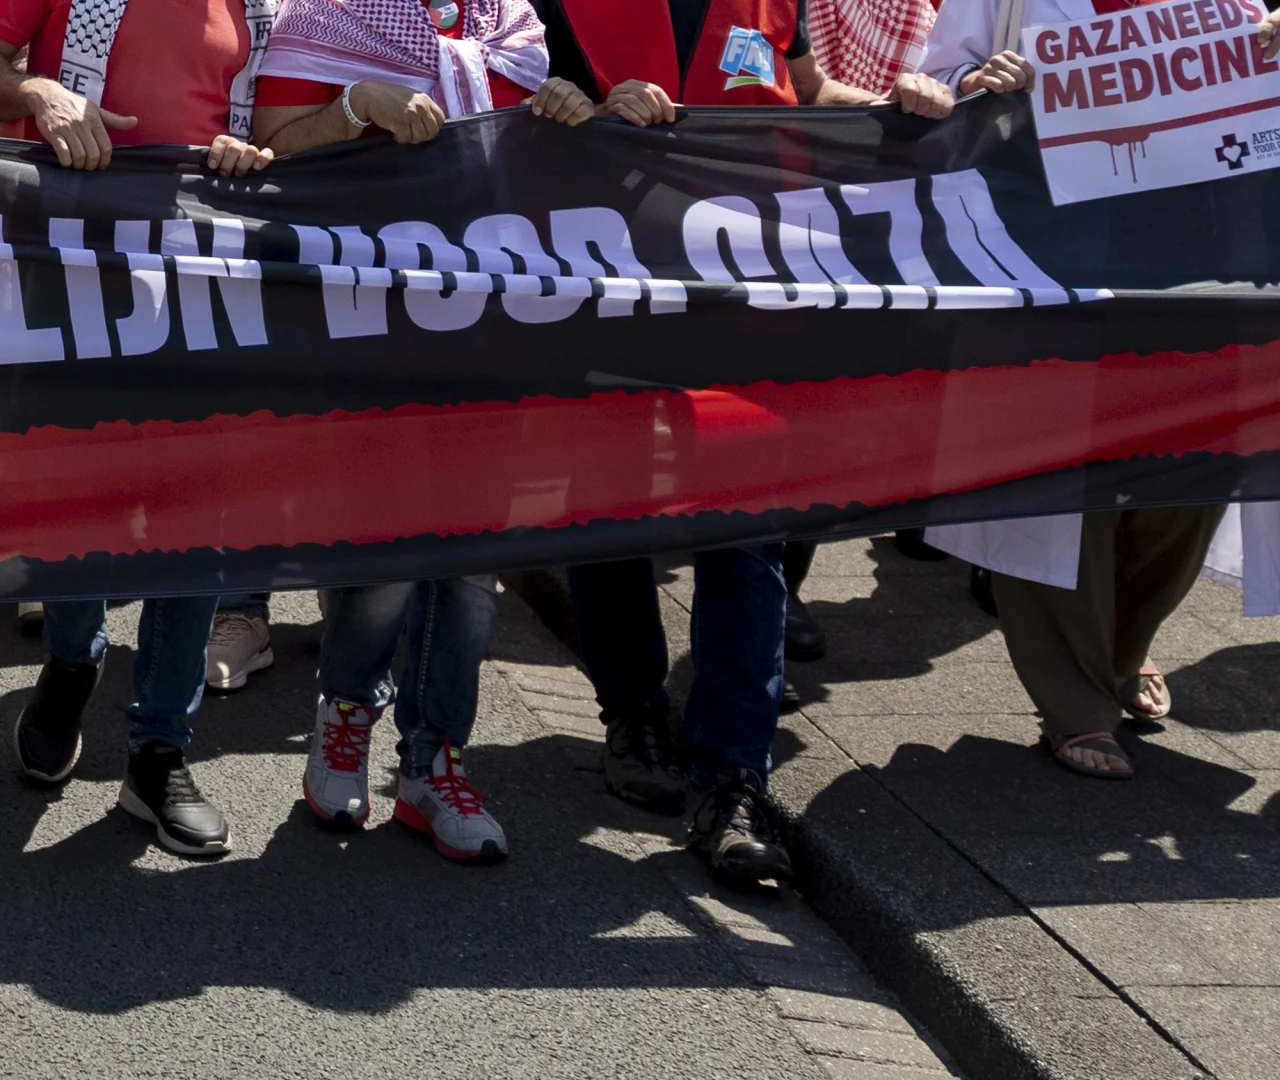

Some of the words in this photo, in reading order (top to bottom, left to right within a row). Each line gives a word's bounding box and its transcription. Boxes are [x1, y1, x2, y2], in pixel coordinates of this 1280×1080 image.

[1035, 15, 1148, 65] GAZA
[1042, 31, 1280, 114] MEDICINE
[1253, 143, 1277, 155] VOOR
